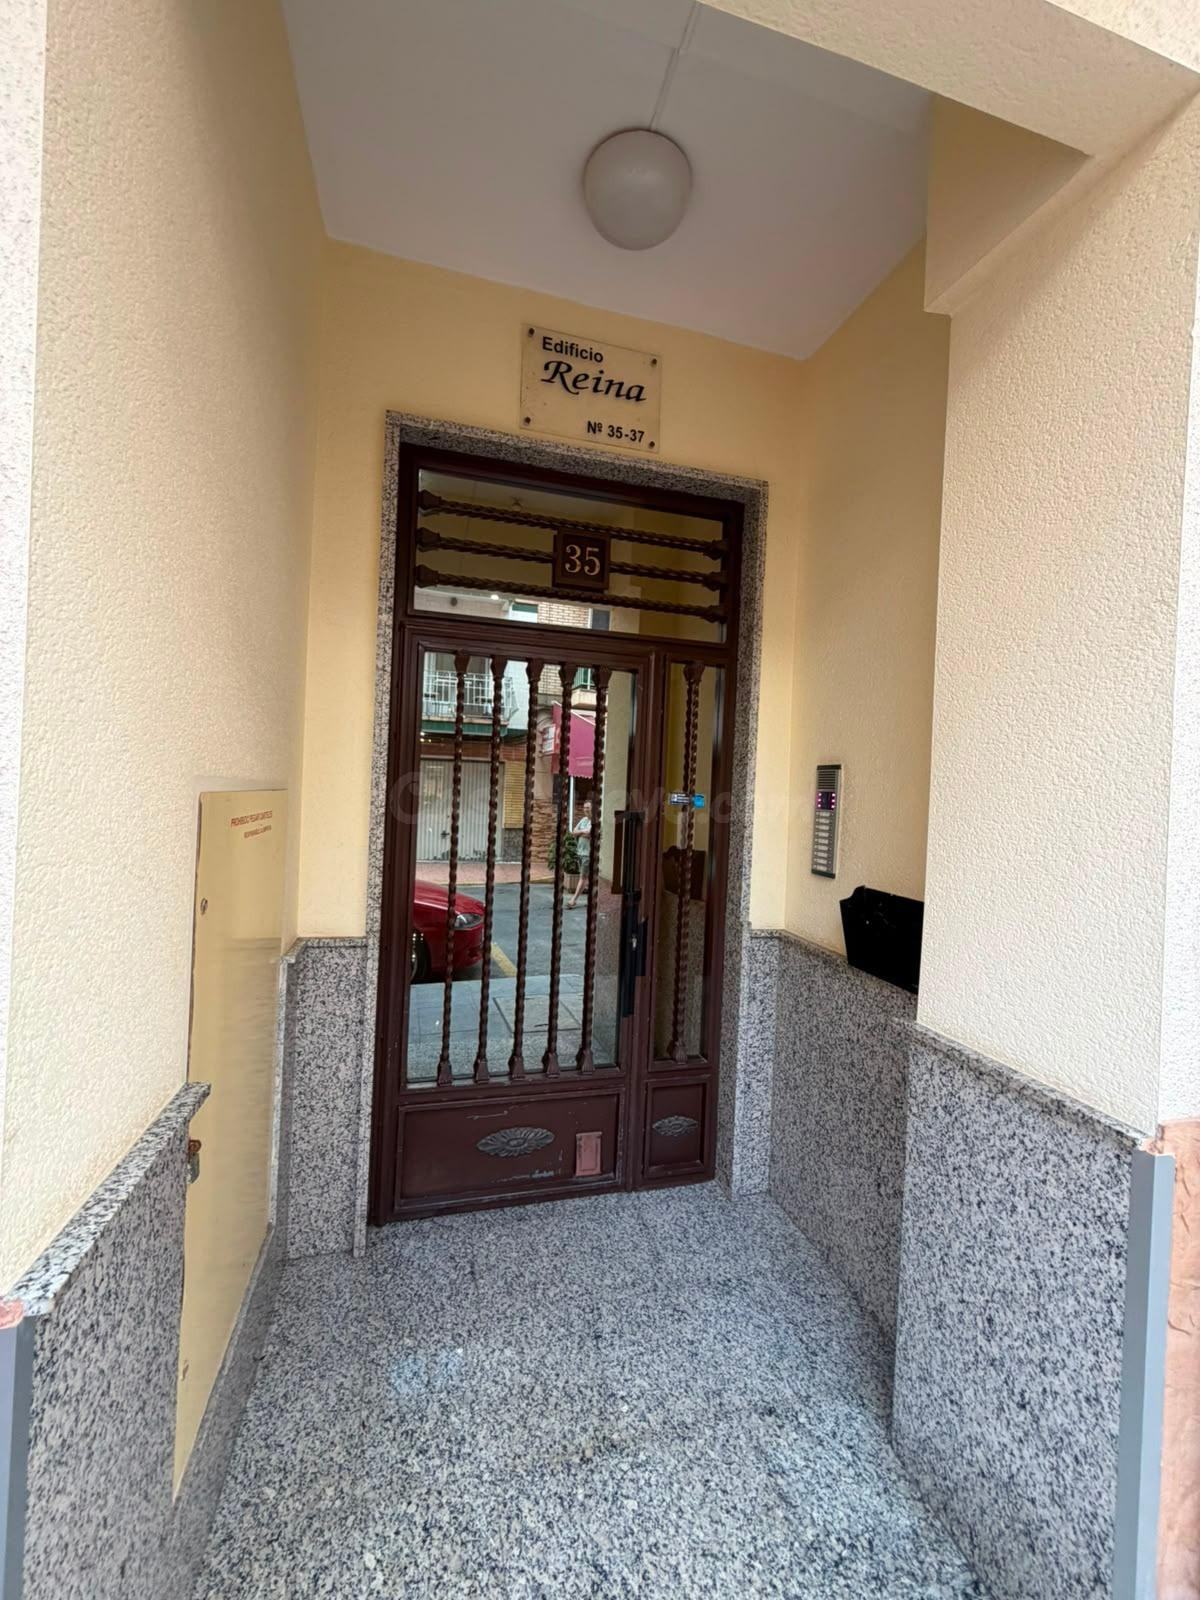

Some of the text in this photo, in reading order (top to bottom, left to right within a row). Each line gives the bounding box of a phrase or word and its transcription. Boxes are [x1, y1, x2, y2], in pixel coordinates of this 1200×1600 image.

[542, 336, 604, 363] Edificio
[541, 360, 647, 402] Reina
[607, 424, 645, 443] 35-37
[565, 544, 601, 576] 35
